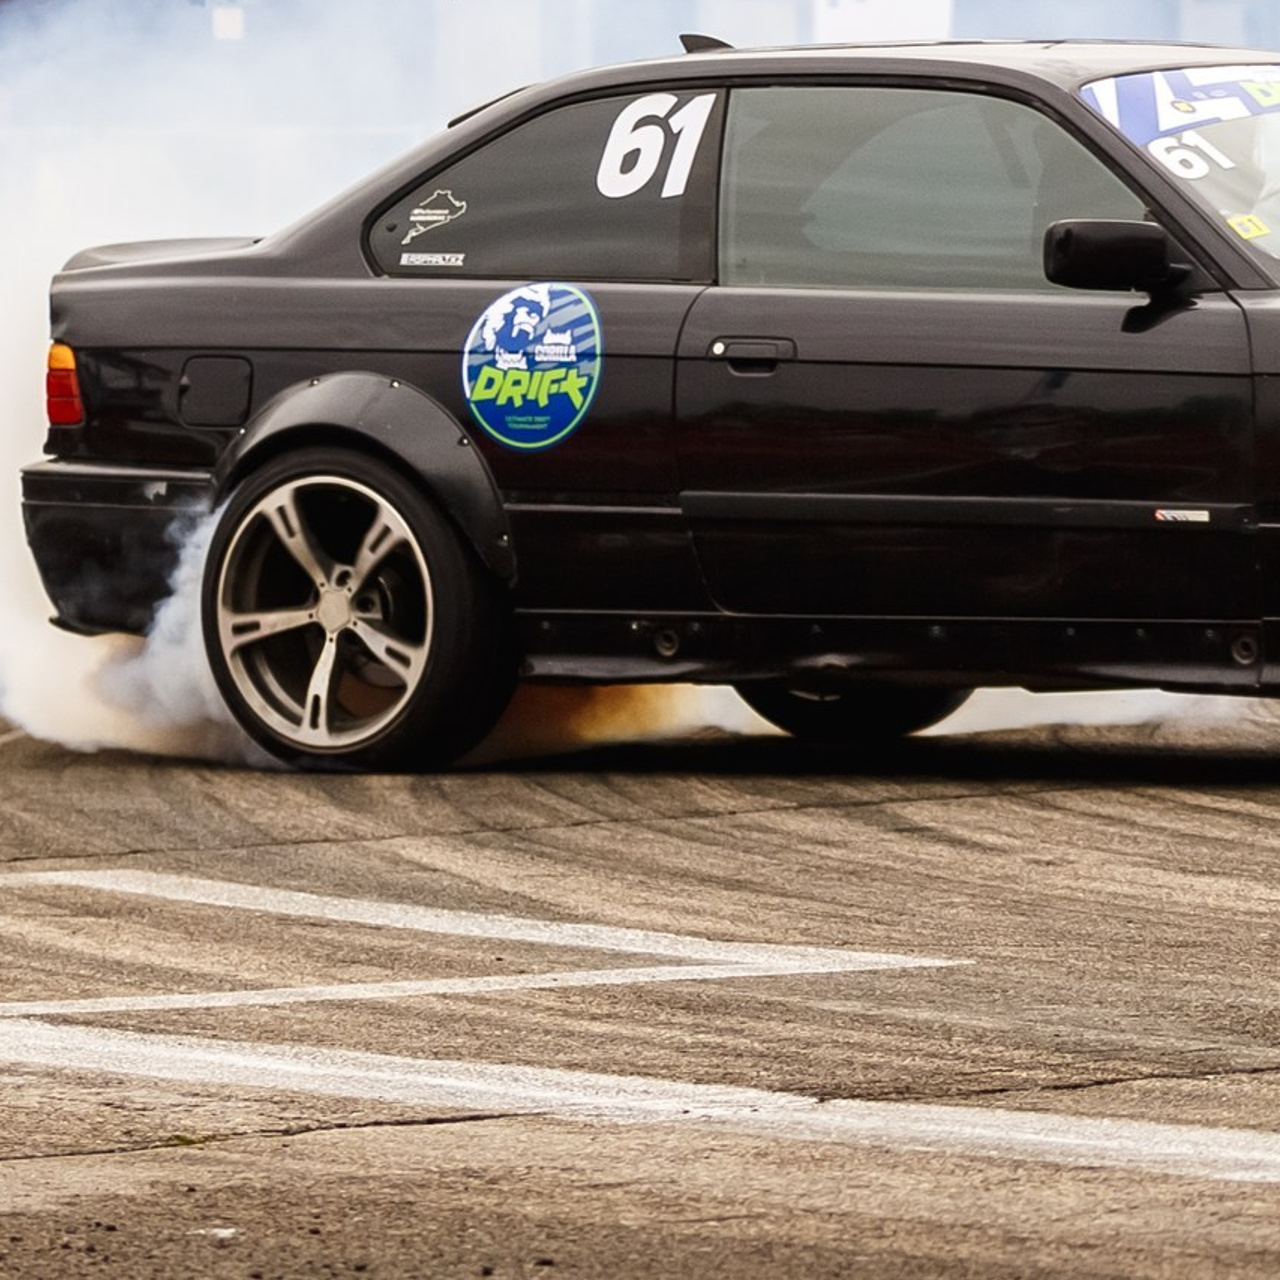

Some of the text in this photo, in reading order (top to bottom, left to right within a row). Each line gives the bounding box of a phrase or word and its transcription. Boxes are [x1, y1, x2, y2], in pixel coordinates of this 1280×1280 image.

[595, 92, 718, 199] 61
[1147, 129, 1236, 180] 61
[471, 364, 588, 411] DRIFT
